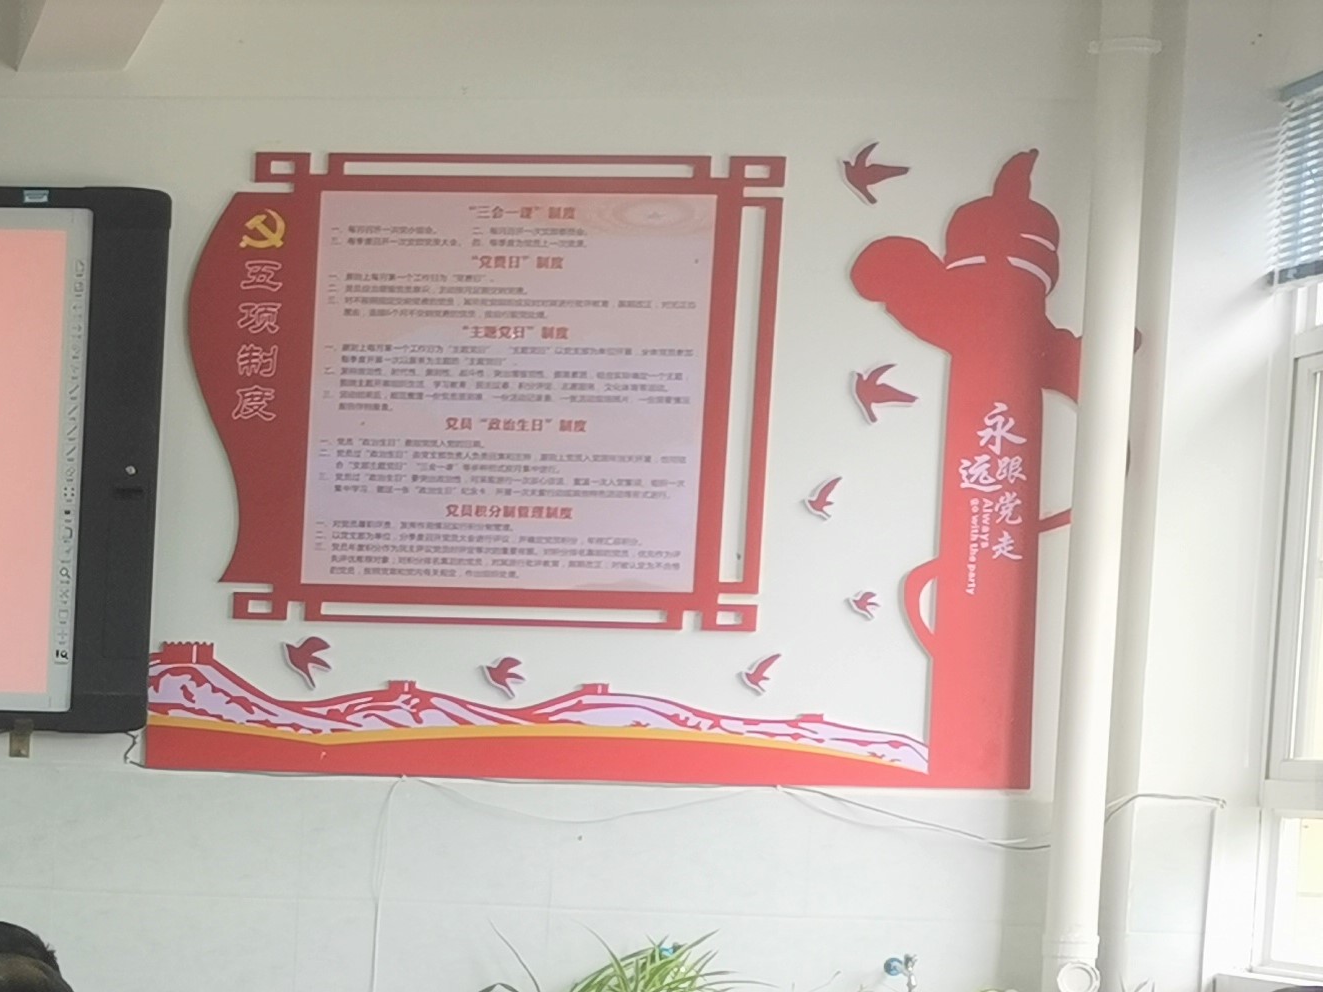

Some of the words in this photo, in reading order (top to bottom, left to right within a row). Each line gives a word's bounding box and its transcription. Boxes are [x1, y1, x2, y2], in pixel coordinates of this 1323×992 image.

[231, 259, 283, 423] 五项制度
[968, 514, 979, 541] with
[979, 498, 994, 549] Always
[967, 542, 979, 562] the
[964, 563, 976, 596] party
